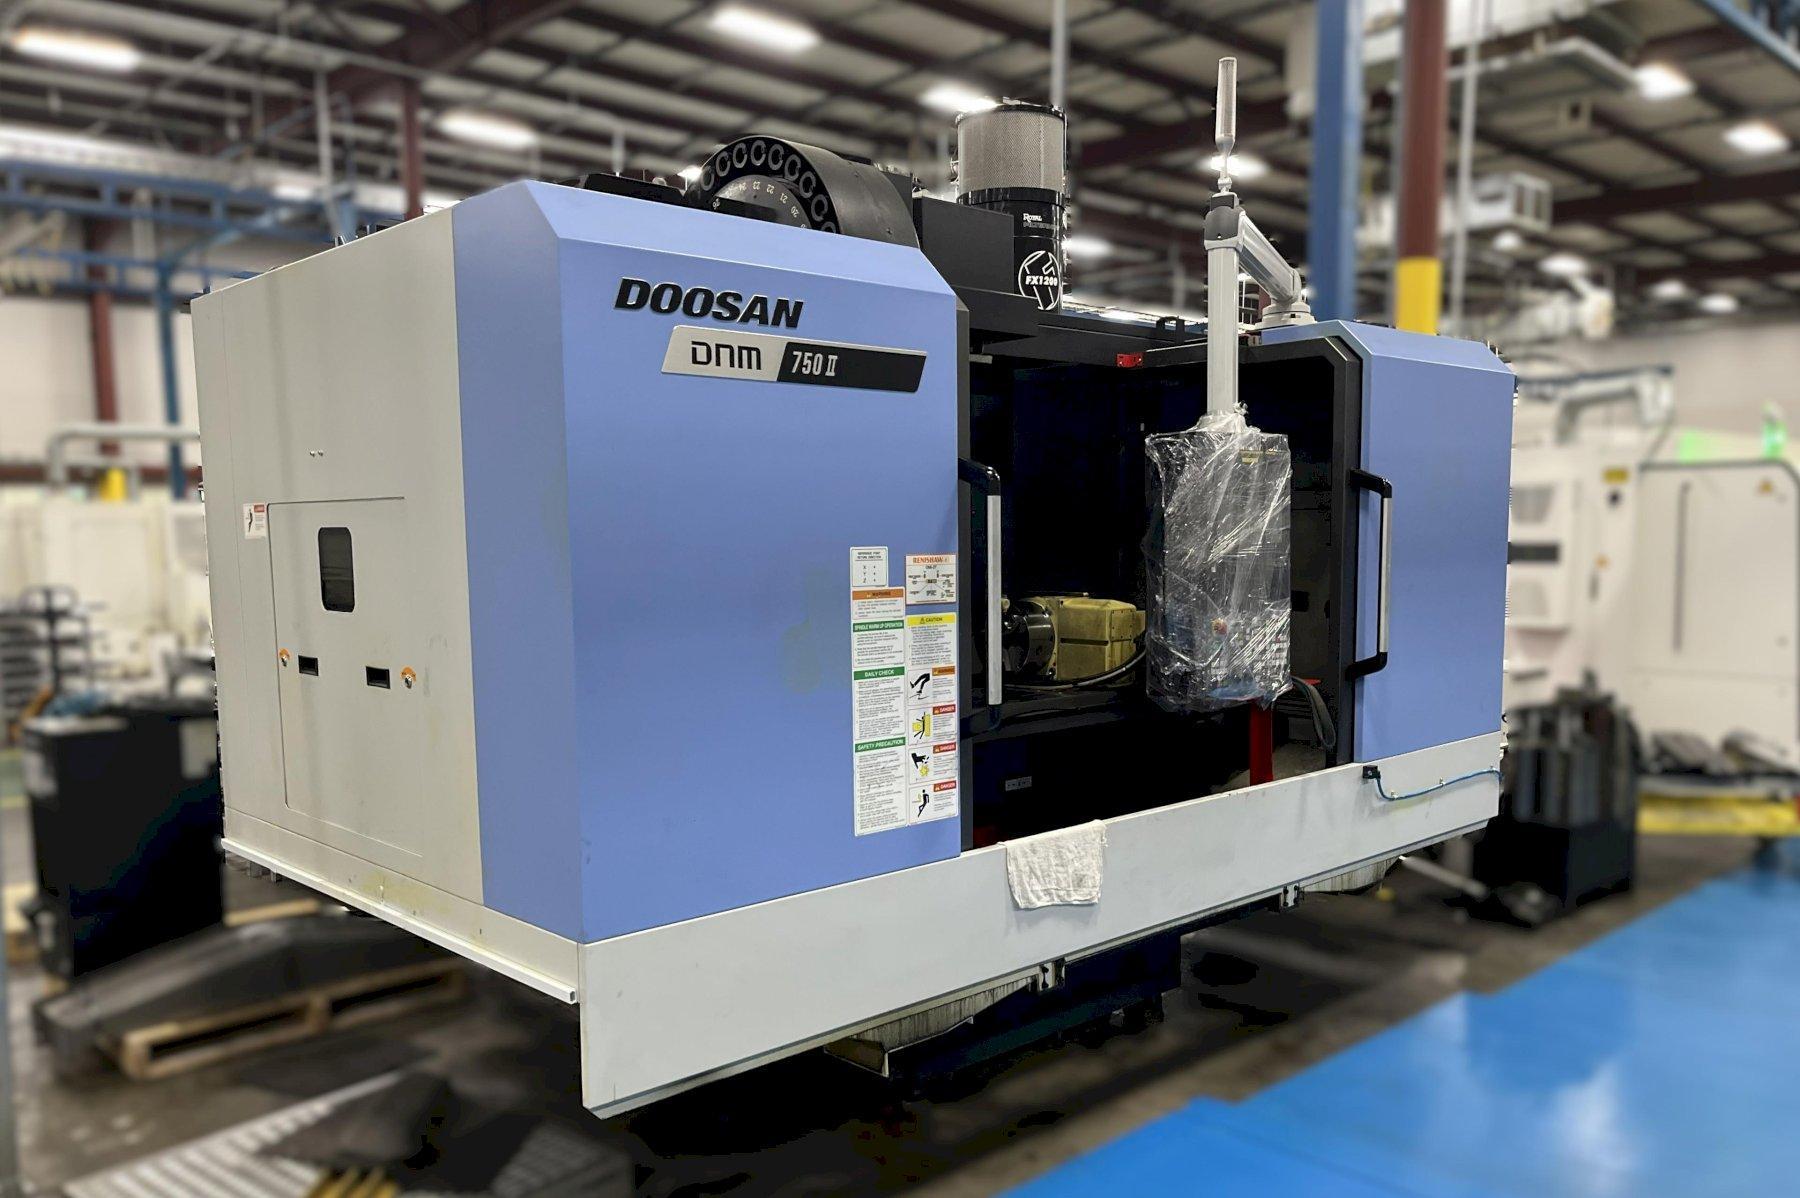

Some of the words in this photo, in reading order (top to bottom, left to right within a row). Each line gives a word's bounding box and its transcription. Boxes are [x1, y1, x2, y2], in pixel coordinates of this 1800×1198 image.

[766, 184, 775, 194] 22
[780, 193, 788, 204] 21
[1025, 275, 1058, 287] FX1200
[614, 277, 804, 328] DOOSAN
[792, 351, 823, 376] 750
[857, 742, 875, 751] SAFETY
